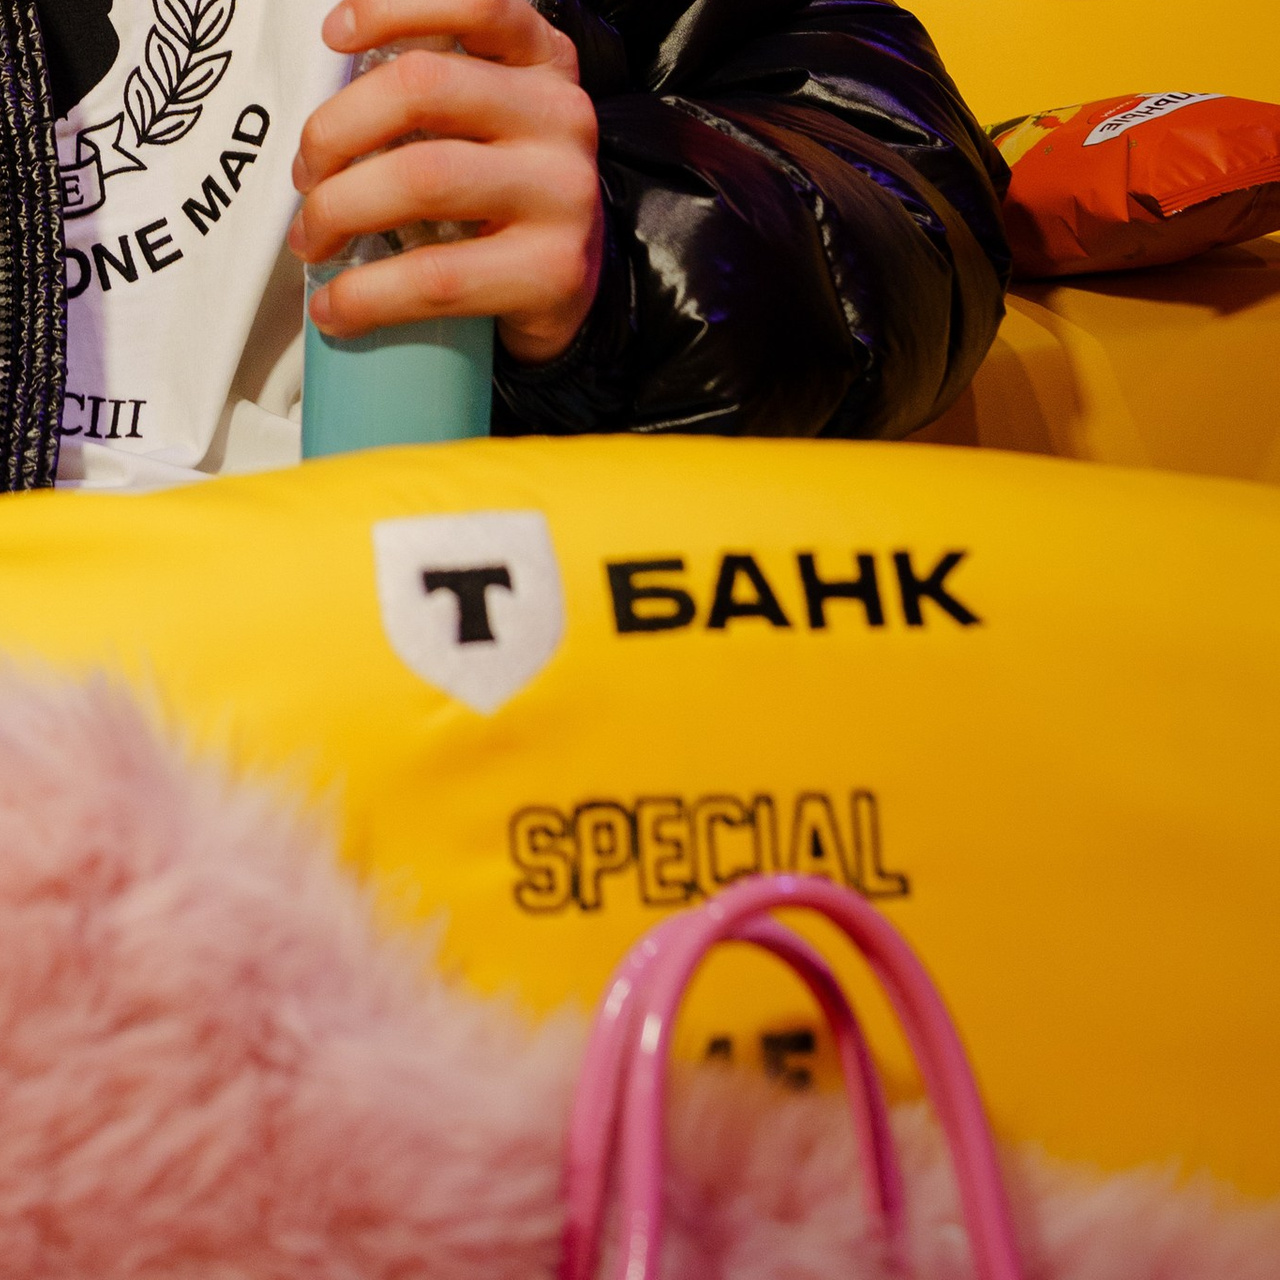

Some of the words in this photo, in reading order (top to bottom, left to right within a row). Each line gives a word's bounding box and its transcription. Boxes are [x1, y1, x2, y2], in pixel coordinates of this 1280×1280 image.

[181, 104, 270, 237] MAD
[604, 548, 984, 635] БАНК
[508, 788, 910, 915] SPECIAL
